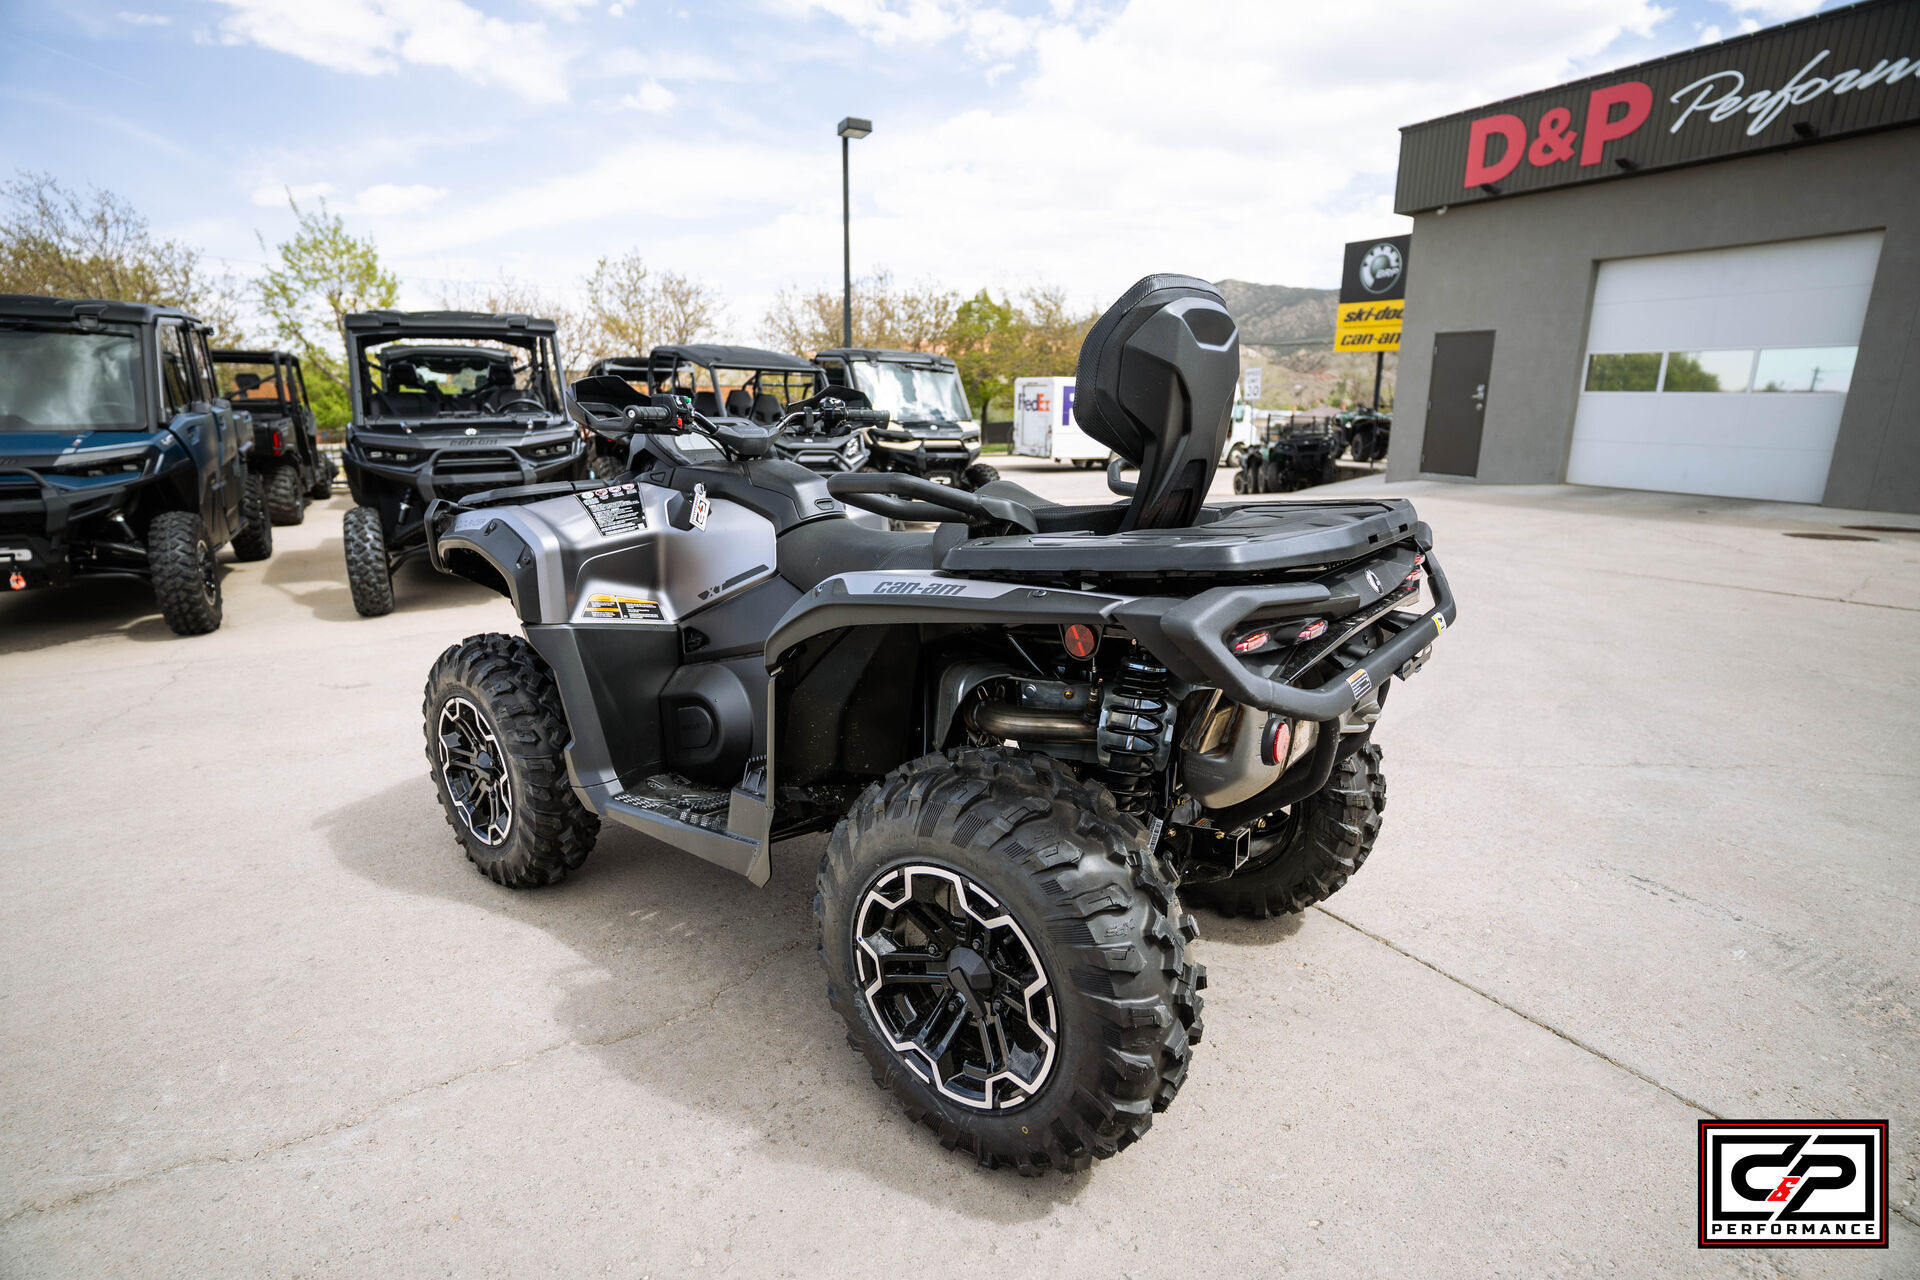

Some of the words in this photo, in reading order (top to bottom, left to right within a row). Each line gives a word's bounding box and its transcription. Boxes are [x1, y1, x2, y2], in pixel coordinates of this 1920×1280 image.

[1463, 81, 1653, 188] D&P
[1018, 393, 1050, 412] FedEx
[872, 581, 967, 596] can-am
